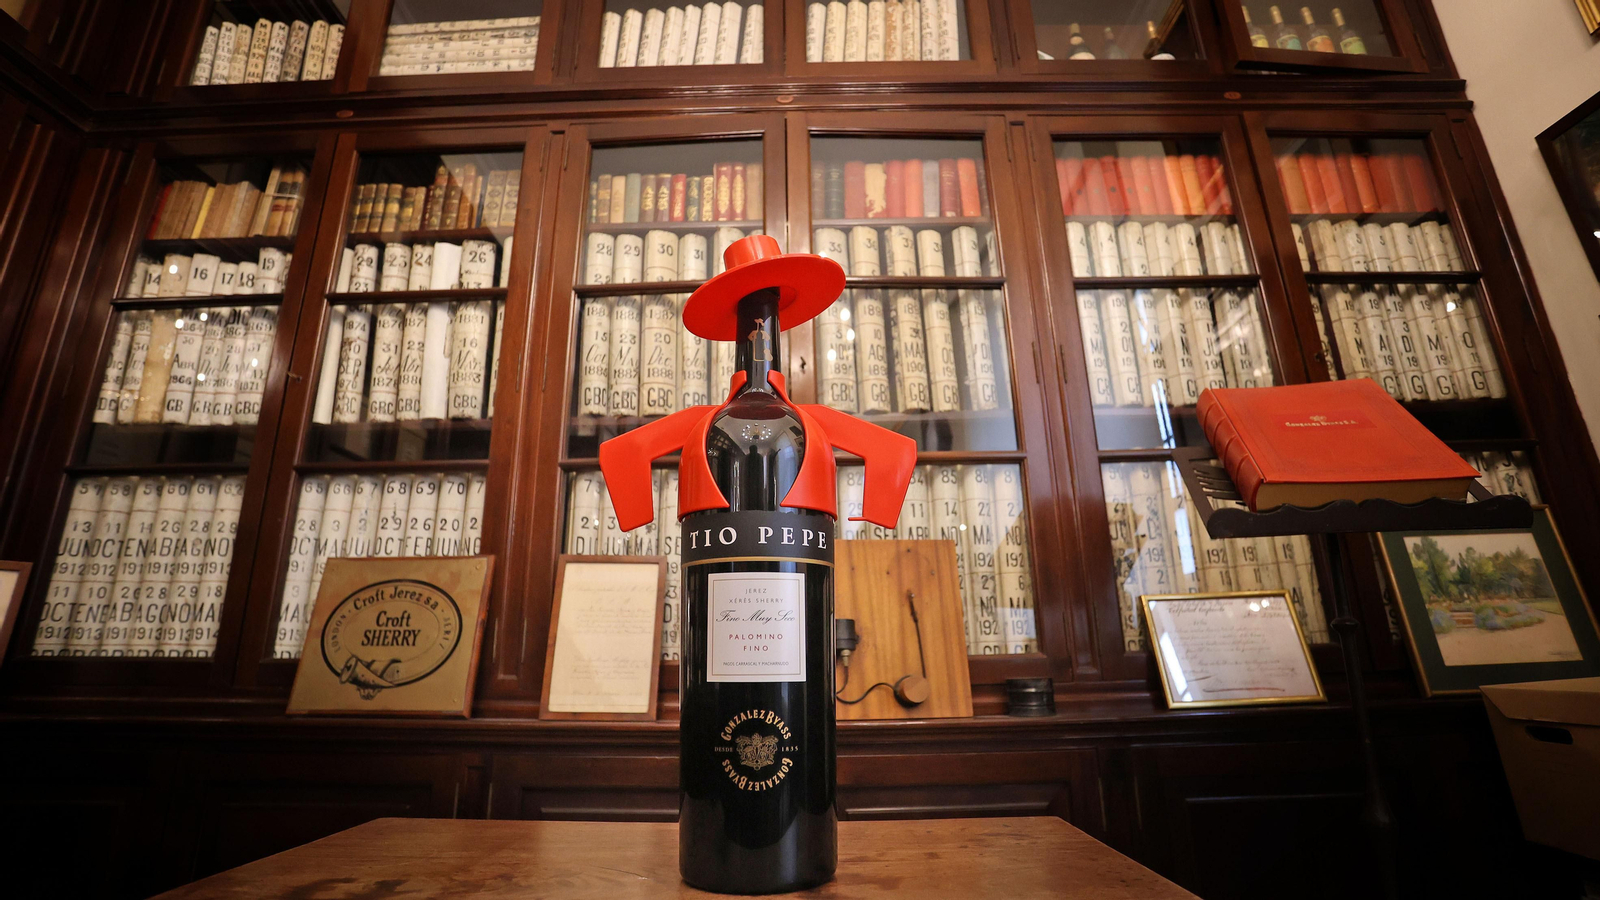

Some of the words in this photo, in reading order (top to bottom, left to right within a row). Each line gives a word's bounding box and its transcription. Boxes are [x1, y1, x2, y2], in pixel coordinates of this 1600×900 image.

[596, 243, 612, 255] 28
[623, 244, 641, 256] 29
[657, 243, 674, 256] 30
[694, 249, 704, 261] 31
[414, 252, 432, 266] 24
[469, 251, 487, 264] 26
[193, 267, 208, 280] 16
[221, 273, 234, 284] 17
[619, 334, 637, 345] 23
[654, 333, 671, 345] 20
[647, 388, 673, 409] GBC
[941, 469, 957, 484] 85
[110, 483, 131, 496] 58
[386, 481, 407, 494] 68
[416, 481, 436, 495] 69
[447, 481, 465, 495] 70
[910, 503, 924, 517] 11
[945, 502, 957, 517] 14
[72, 521, 92, 533] 13
[190, 520, 210, 533] 28
[217, 521, 237, 534] 29
[298, 519, 317, 531] 28
[380, 517, 402, 530] 29
[410, 517, 432, 530] 26
[440, 518, 460, 531] 20
[690, 526, 737, 549] TIO
[758, 526, 827, 549] PEPE
[53, 586, 70, 598] 11
[88, 586, 107, 599] 10
[145, 586, 167, 599] 28
[177, 585, 198, 598] 29
[207, 586, 223, 598] 18
[353, 590, 385, 610] Croft
[389, 586, 423, 601] Jerez
[376, 610, 411, 627] Croft
[715, 610, 740, 622] Fino
[742, 610, 772, 625] Muy
[361, 629, 421, 647] SHERRY
